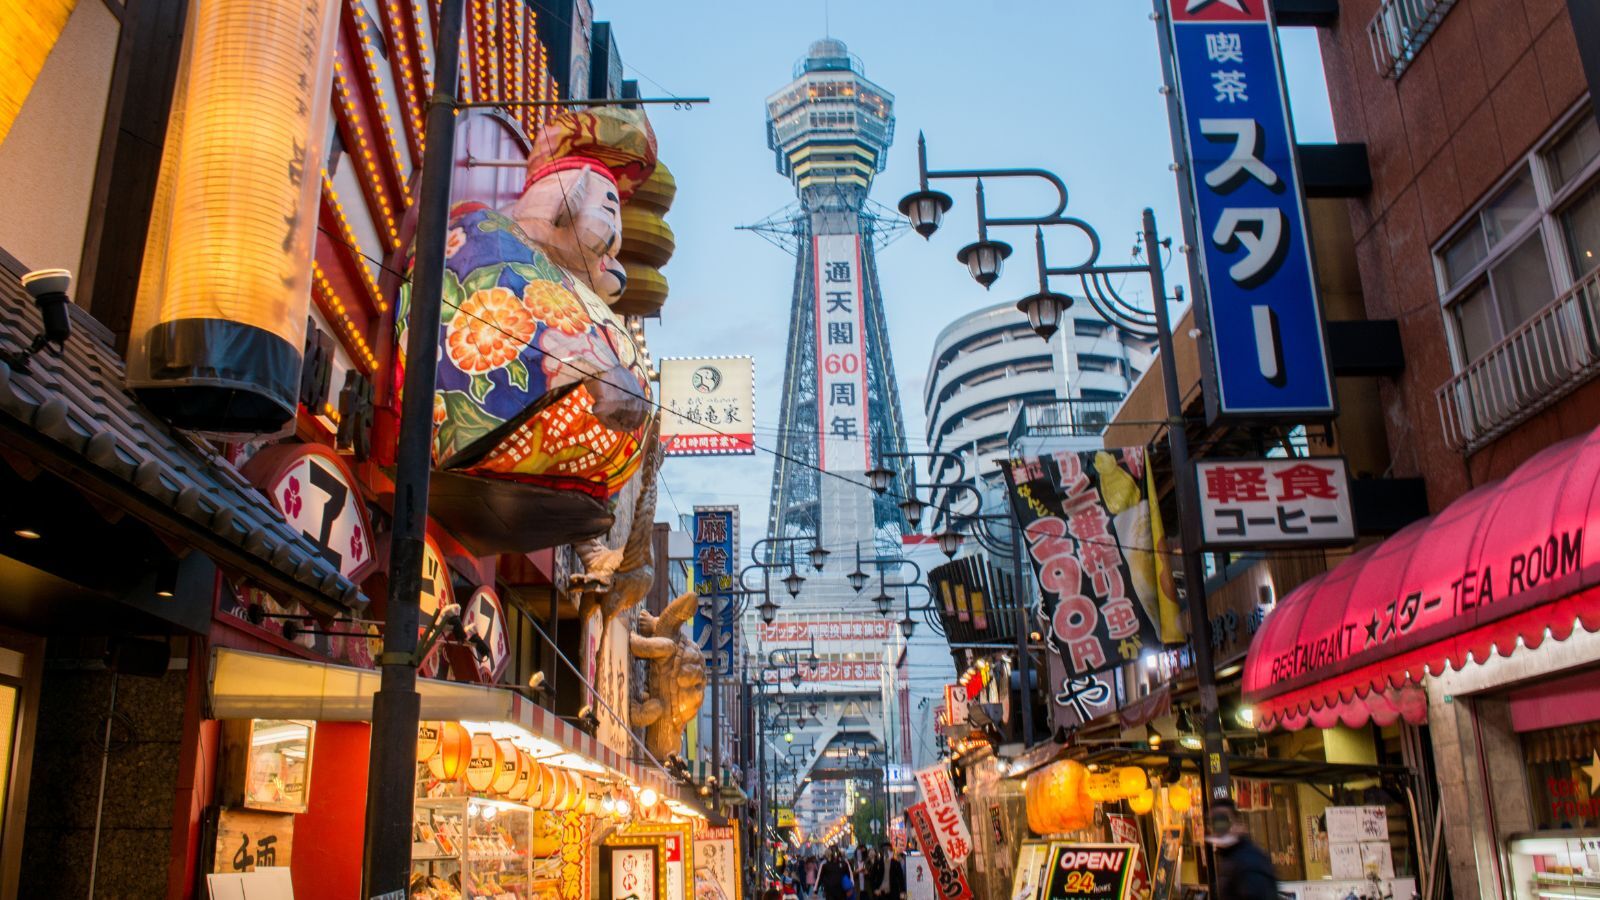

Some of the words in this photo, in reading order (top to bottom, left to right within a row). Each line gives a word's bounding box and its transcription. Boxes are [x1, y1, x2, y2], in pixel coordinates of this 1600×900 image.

[1205, 32, 1249, 104] 喫茶
[1199, 118, 1280, 380] スター
[1205, 462, 1338, 504] 軽食
[696, 513, 729, 576] 麻雀
[1214, 505, 1338, 537] コーヒー
[1272, 623, 1357, 683] RESTAURANT
[1382, 592, 1443, 640] スター
[1452, 568, 1494, 617] TEA
[1509, 528, 1583, 596] ROOM
[1060, 851, 1124, 872] OPEN!
[1065, 871, 1094, 893] 24
